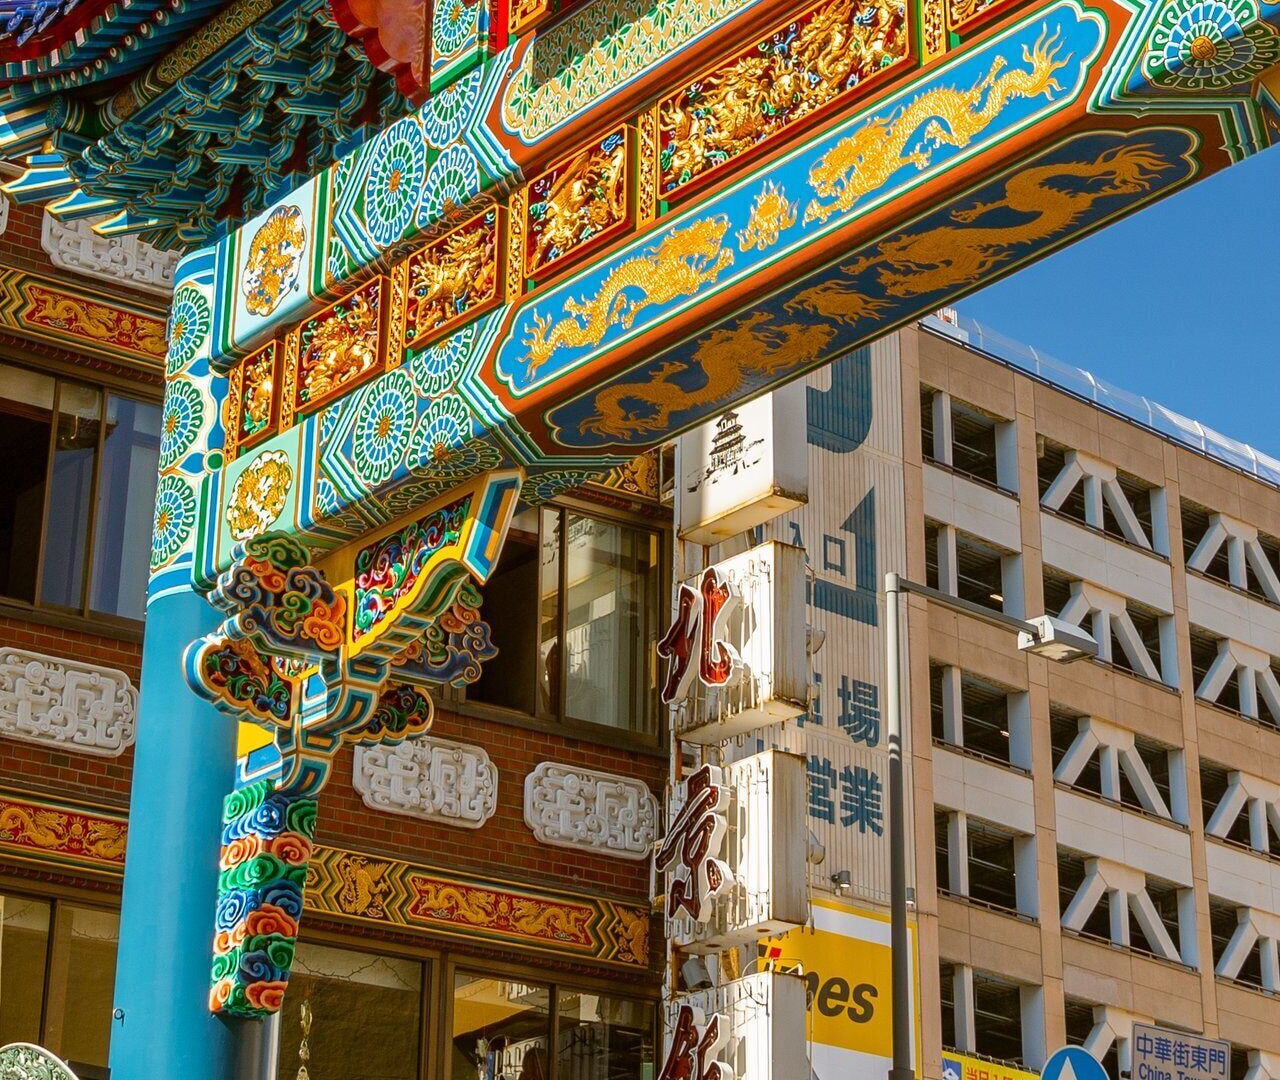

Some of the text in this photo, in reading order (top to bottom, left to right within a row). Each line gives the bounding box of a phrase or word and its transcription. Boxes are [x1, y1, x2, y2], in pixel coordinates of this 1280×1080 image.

[1136, 1033, 1226, 1075] 中華街東門
